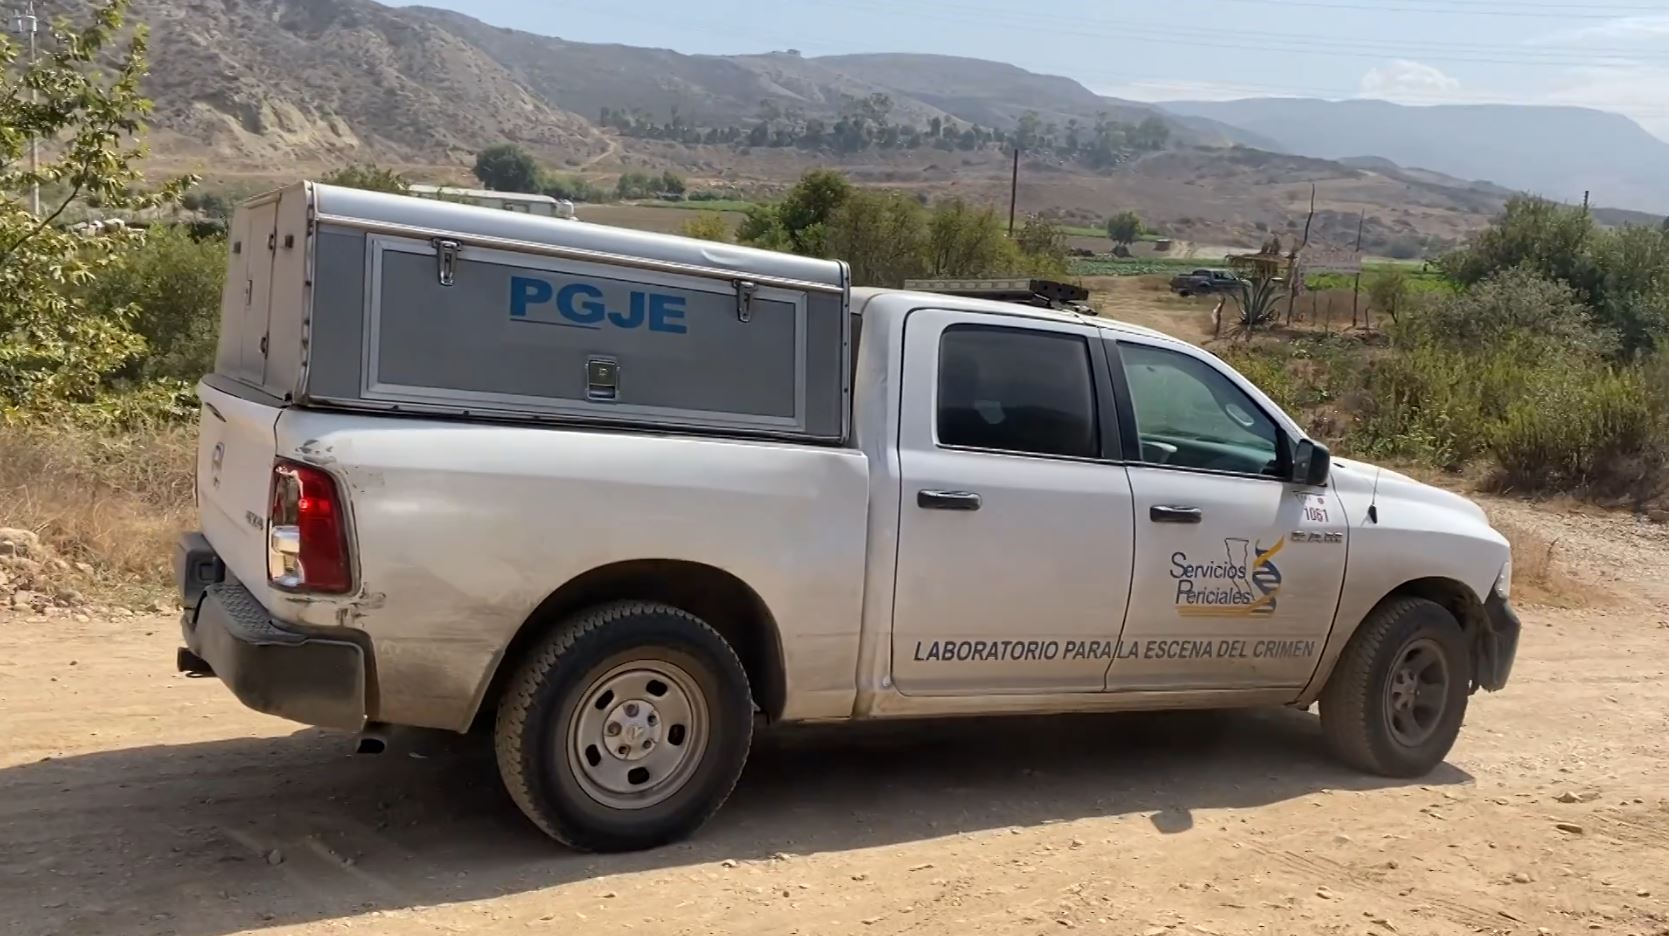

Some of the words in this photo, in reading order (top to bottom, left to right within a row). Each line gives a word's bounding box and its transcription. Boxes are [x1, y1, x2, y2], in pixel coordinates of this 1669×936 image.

[510, 276, 687, 334] PGJE
[1304, 507, 1329, 523] 1061
[1170, 552, 1247, 579] Servicios
[1175, 579, 1250, 605] Periciales
[914, 641, 1059, 661] LABORATORIO
[1063, 641, 1112, 660] PARA
[1116, 641, 1139, 659] LA
[1144, 640, 1213, 660] ESCENA
[1217, 640, 1249, 659] DEL
[1253, 640, 1316, 659] CRIMEN
